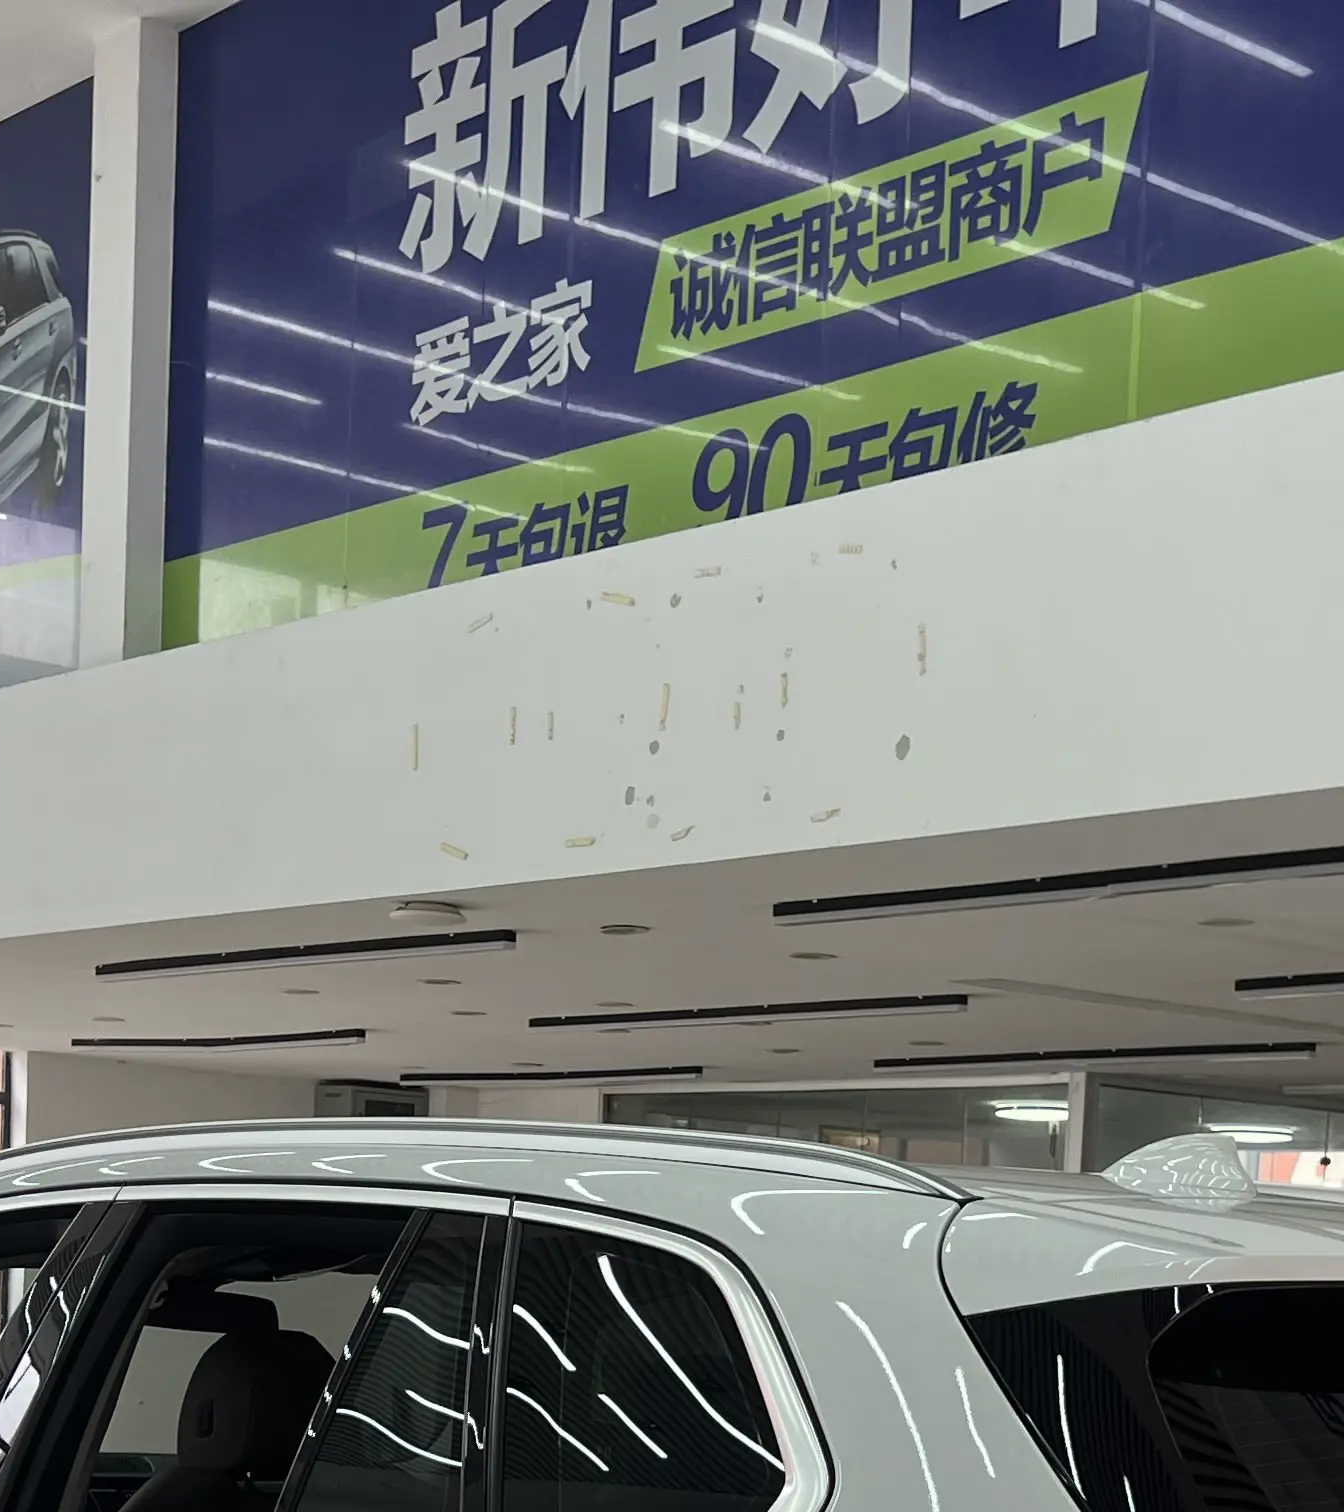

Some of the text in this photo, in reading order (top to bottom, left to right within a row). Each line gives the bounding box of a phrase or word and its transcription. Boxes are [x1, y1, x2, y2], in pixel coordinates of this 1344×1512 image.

[669, 112, 1107, 340] 诚信联盟商户
[410, 277, 594, 428] 爱之家
[420, 381, 1040, 590] 7天包退 90天包修
